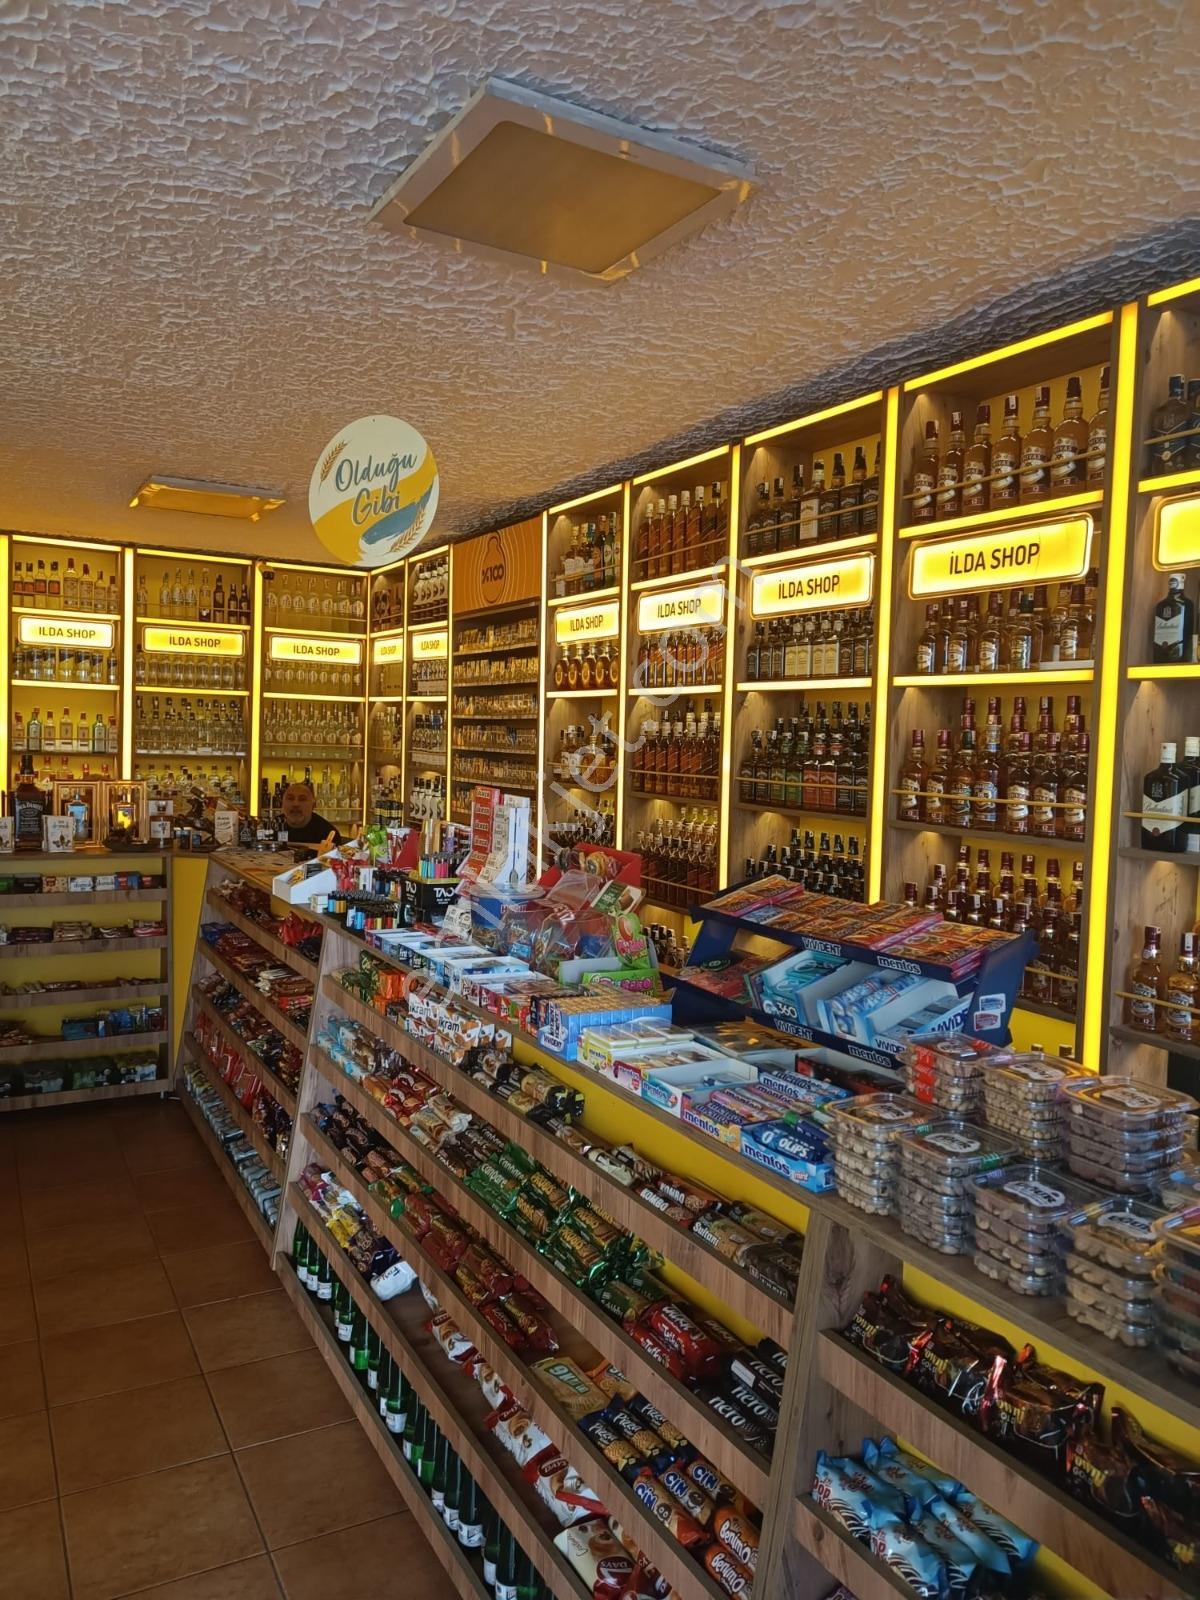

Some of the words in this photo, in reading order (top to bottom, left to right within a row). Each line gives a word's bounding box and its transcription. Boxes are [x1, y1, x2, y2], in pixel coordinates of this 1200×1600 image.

[335, 452, 418, 493] Olduğu
[352, 485, 400, 525] Gibi
[949, 549, 986, 576] İLDA
[990, 542, 1041, 570] SHOP
[778, 578, 804, 600] İLDA
[806, 574, 841, 596] SHOP
[677, 598, 702, 615] SHOP
[66, 628, 96, 639] SHOP
[585, 614, 604, 630] SHOP
[194, 638, 221, 648] SHOP
[315, 646, 340, 657] SHOP
[433, 886, 455, 898] TAO
[877, 955, 922, 975] mentos
[775, 1001, 798, 1018] 360
[849, 1044, 892, 1068] mentos
[762, 1076, 801, 1100] mentos
[684, 1111, 721, 1138] mentos
[744, 1143, 791, 1177] mentos
[640, 1187, 670, 1212] KOMBO
[692, 1220, 722, 1247] Sultani
[852, 1313, 881, 1337] rowni
[924, 1347, 950, 1375] rowni
[750, 1360, 784, 1387] nero
[708, 1395, 745, 1427] nero
[730, 1385, 768, 1417] nero
[588, 1422, 619, 1442] Pizza
[613, 1412, 642, 1432] Pizza
